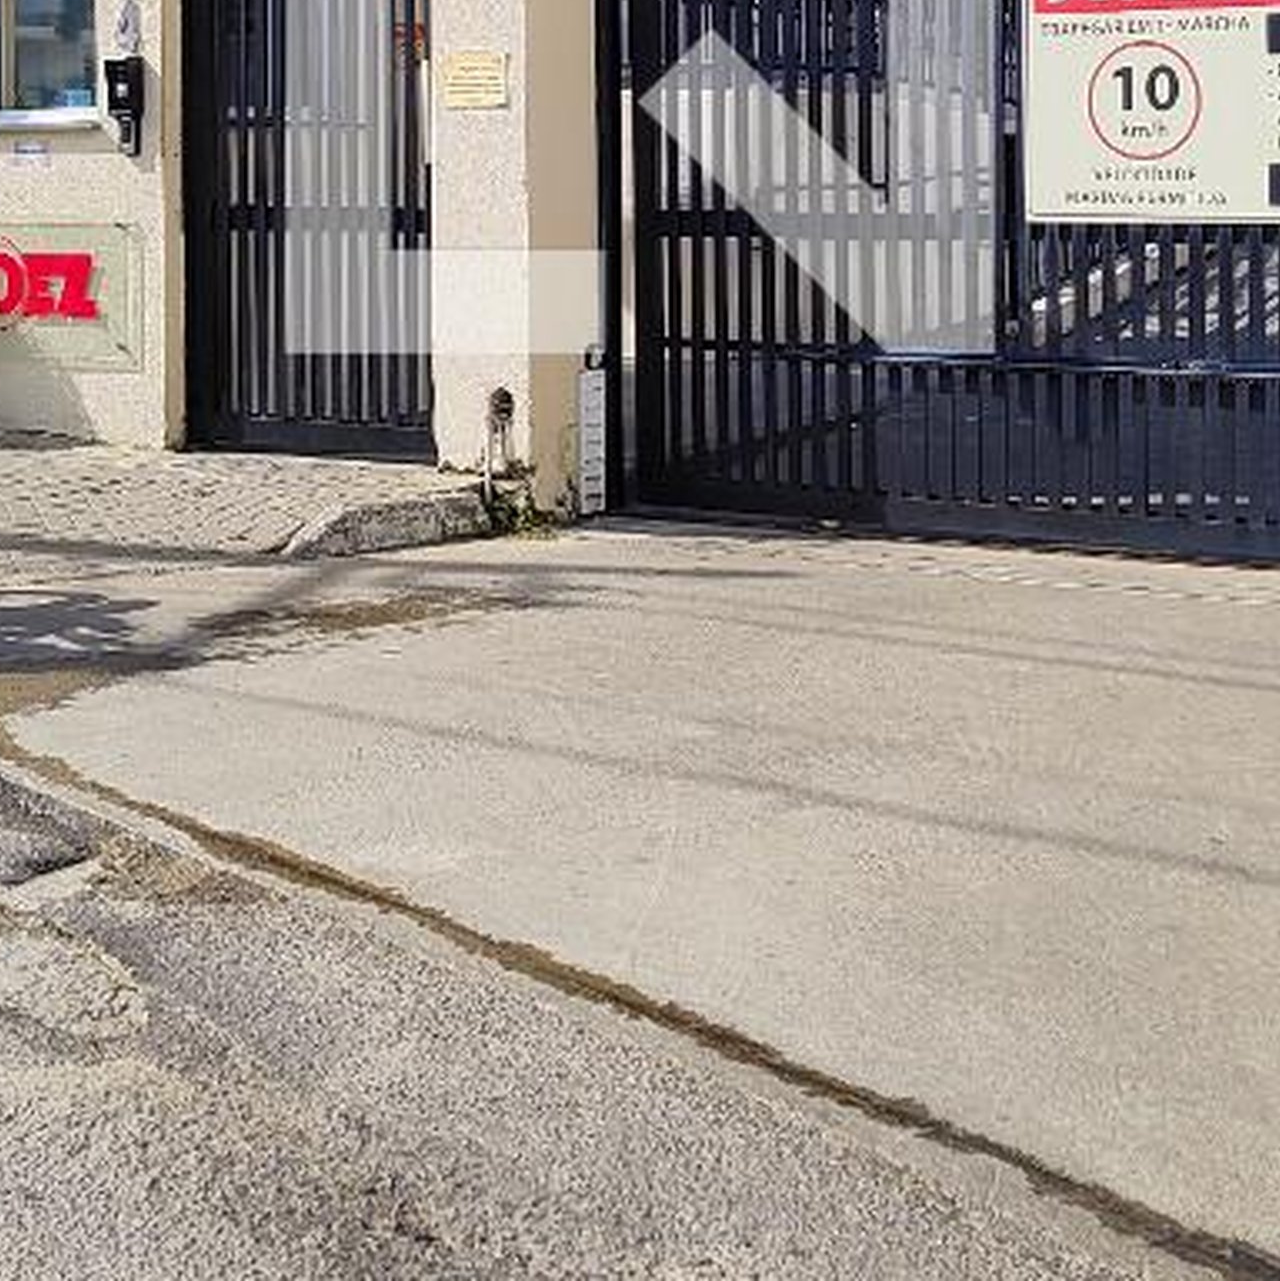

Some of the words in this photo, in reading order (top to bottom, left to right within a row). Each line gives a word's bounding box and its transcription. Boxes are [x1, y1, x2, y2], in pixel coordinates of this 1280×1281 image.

[1177, 16, 1251, 31] MARCHA
[1112, 63, 1180, 111] 10
[1121, 119, 1170, 138] km/h
